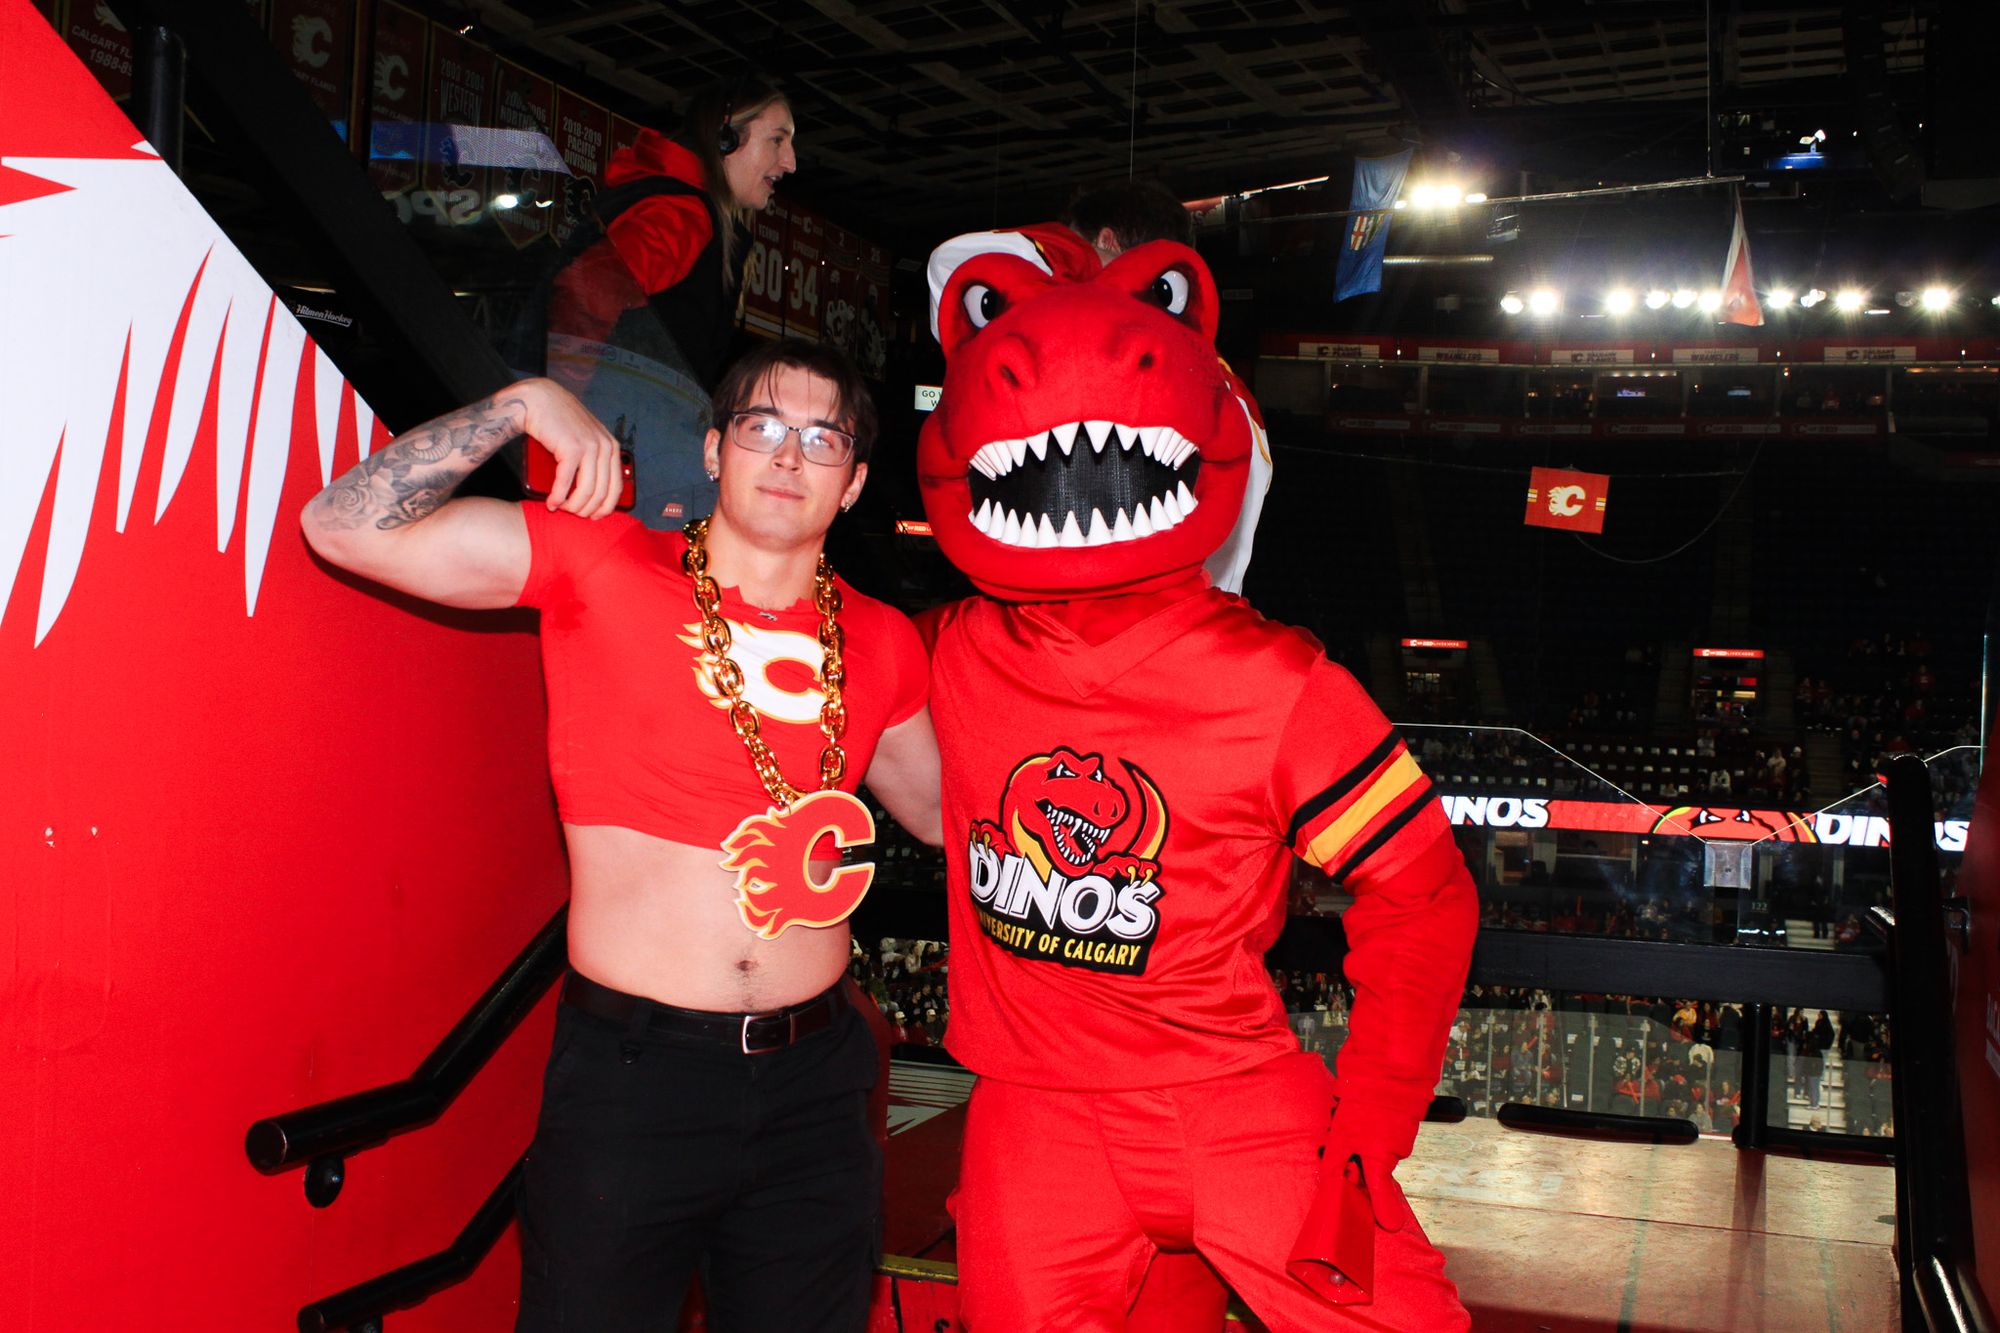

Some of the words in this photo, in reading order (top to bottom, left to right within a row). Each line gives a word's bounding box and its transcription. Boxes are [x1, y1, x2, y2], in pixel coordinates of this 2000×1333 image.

[71, 25, 119, 50] CALGARY
[562, 115, 603, 148] 2018-2019
[564, 148, 598, 177] DIVISION
[789, 256, 819, 318] 34
[922, 390, 936, 398] GO
[969, 842, 1161, 940] DINOS
[1038, 933, 1061, 954] OF
[1064, 938, 1141, 967] CALGARY
